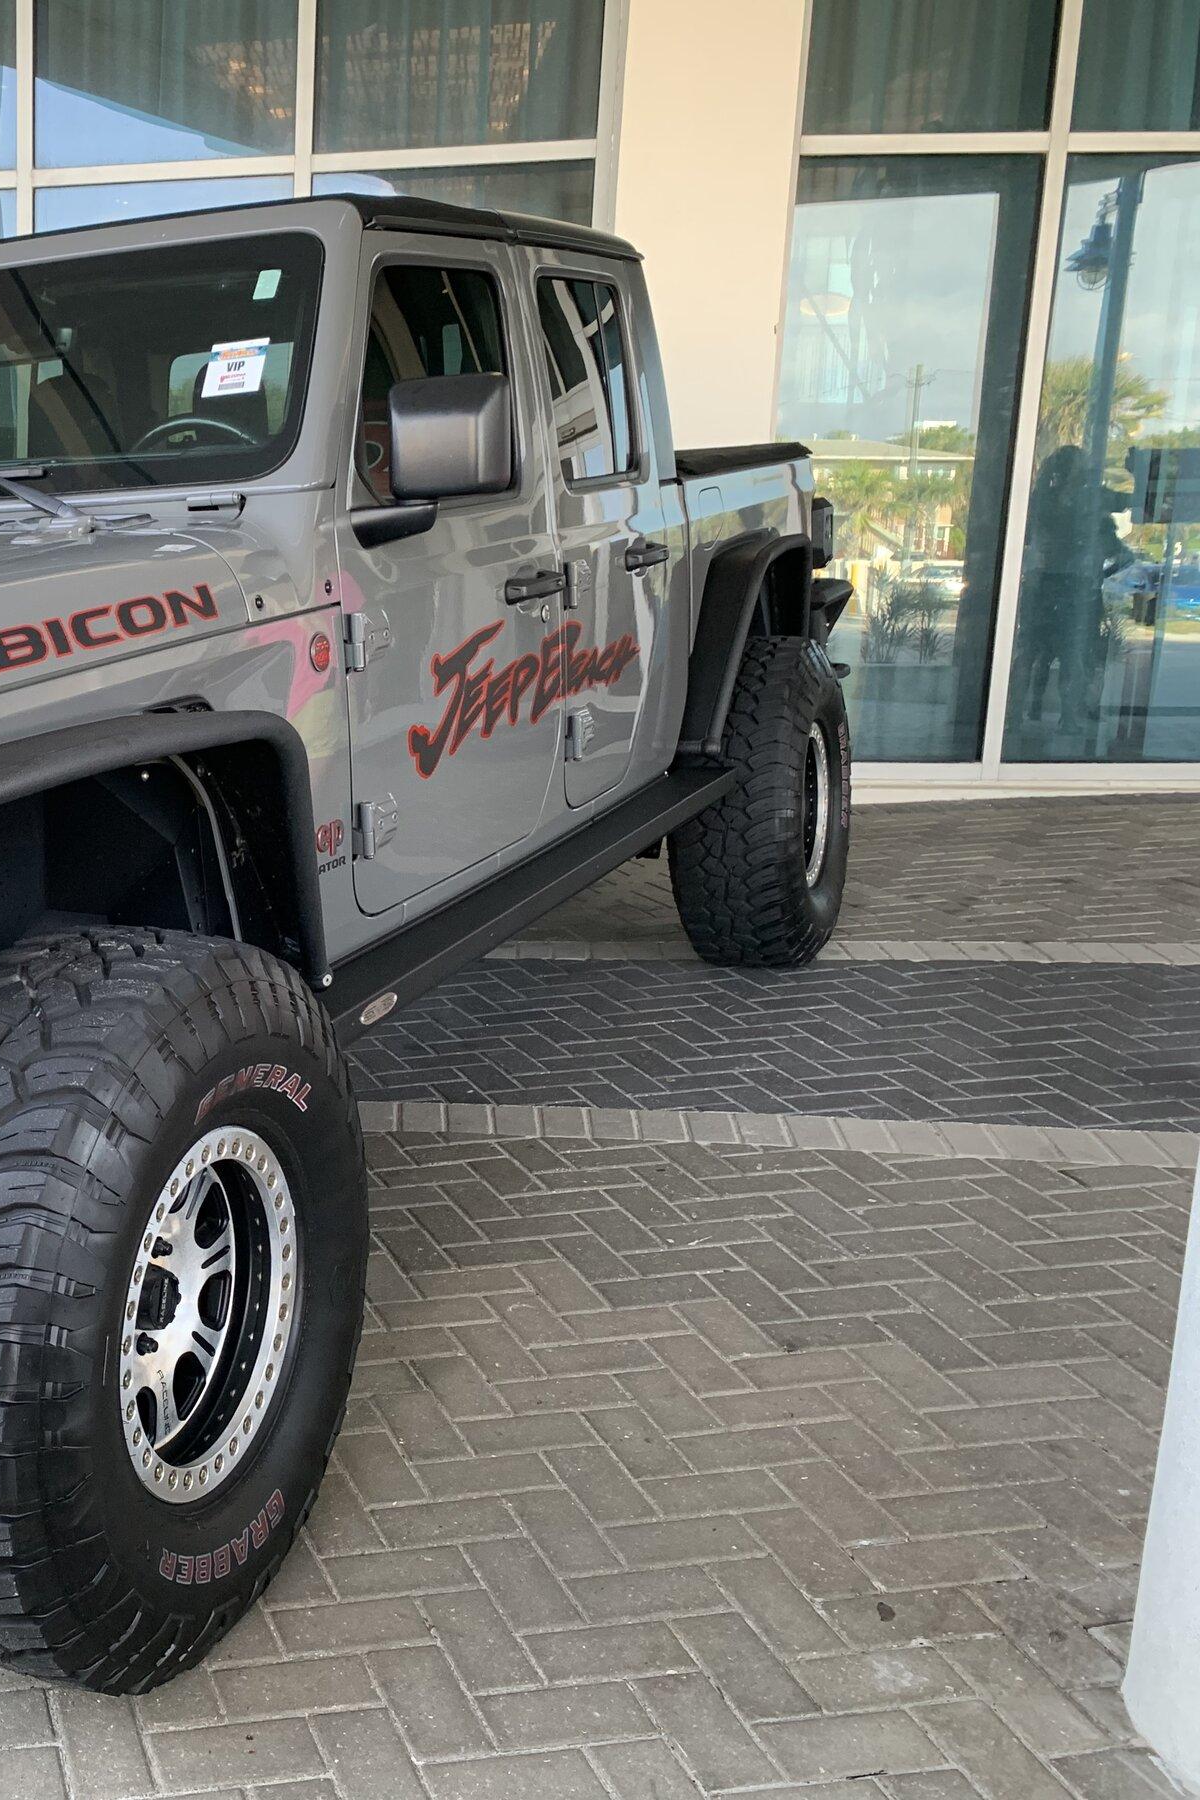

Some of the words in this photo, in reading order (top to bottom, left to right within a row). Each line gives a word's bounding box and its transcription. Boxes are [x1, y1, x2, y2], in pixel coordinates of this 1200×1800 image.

[227, 361, 245, 371] VIP
[316, 819, 344, 857] ep
[194, 1063, 312, 1125] GENERAL
[159, 1488, 286, 1585] GRABBER
